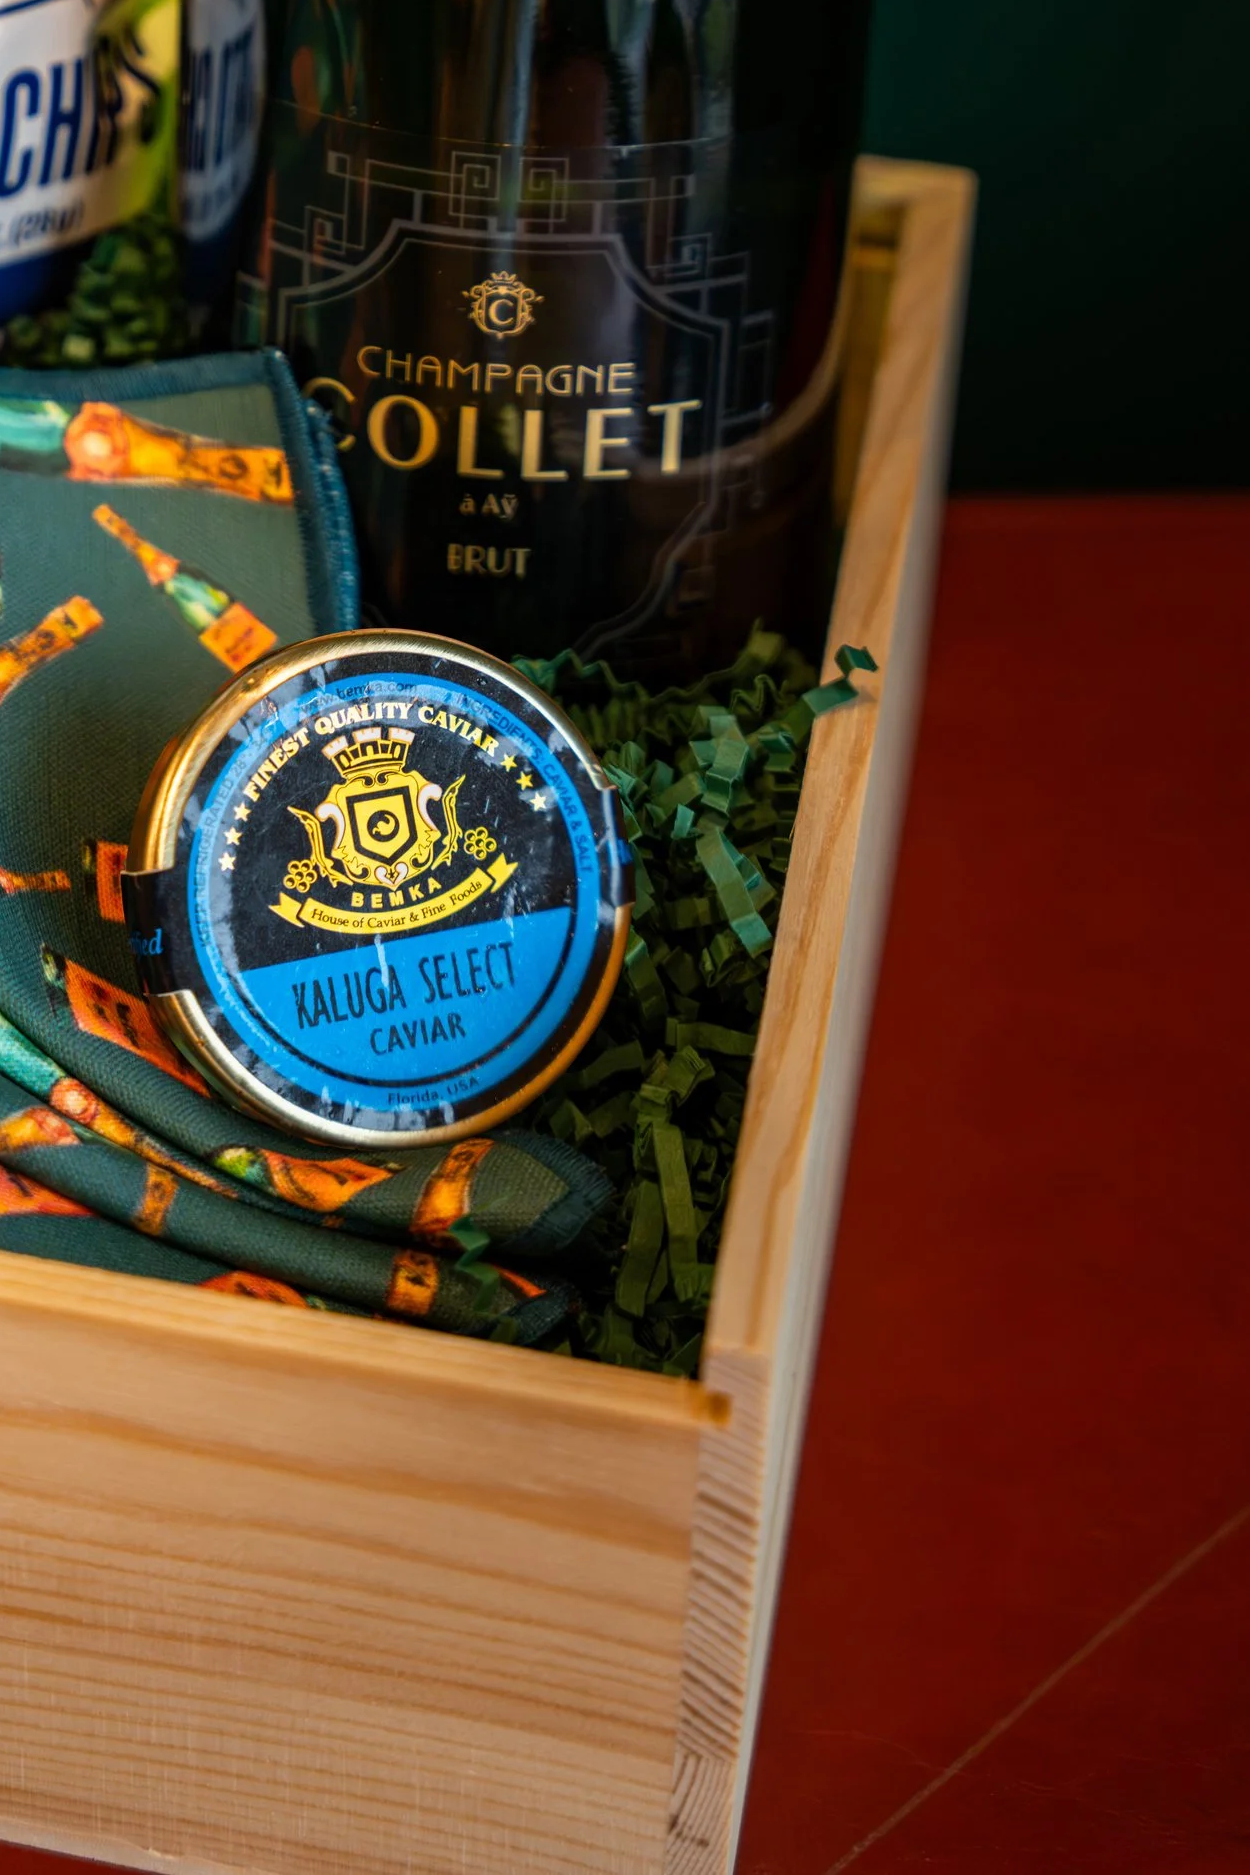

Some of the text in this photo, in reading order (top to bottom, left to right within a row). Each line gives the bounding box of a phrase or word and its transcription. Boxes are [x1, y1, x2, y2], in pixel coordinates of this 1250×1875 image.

[356, 345, 636, 398] CHAMPAGNE
[301, 376, 702, 482] COLLET
[447, 543, 532, 579] BRUT
[243, 702, 500, 802] FINEST QUALITY CAVIAR
[543, 764, 579, 815] CAVIAR
[194, 776, 235, 895] REFRIGERATED
[570, 820, 583, 831] &
[575, 833, 593, 872] SALT
[311, 880, 483, 929] House of Caviar & Fine Foods
[351, 877, 442, 908] BEMKA
[292, 941, 516, 1029] KALUGA SELECT
[370, 1012, 466, 1055] CAVIAR
[447, 1077, 480, 1095] USA
